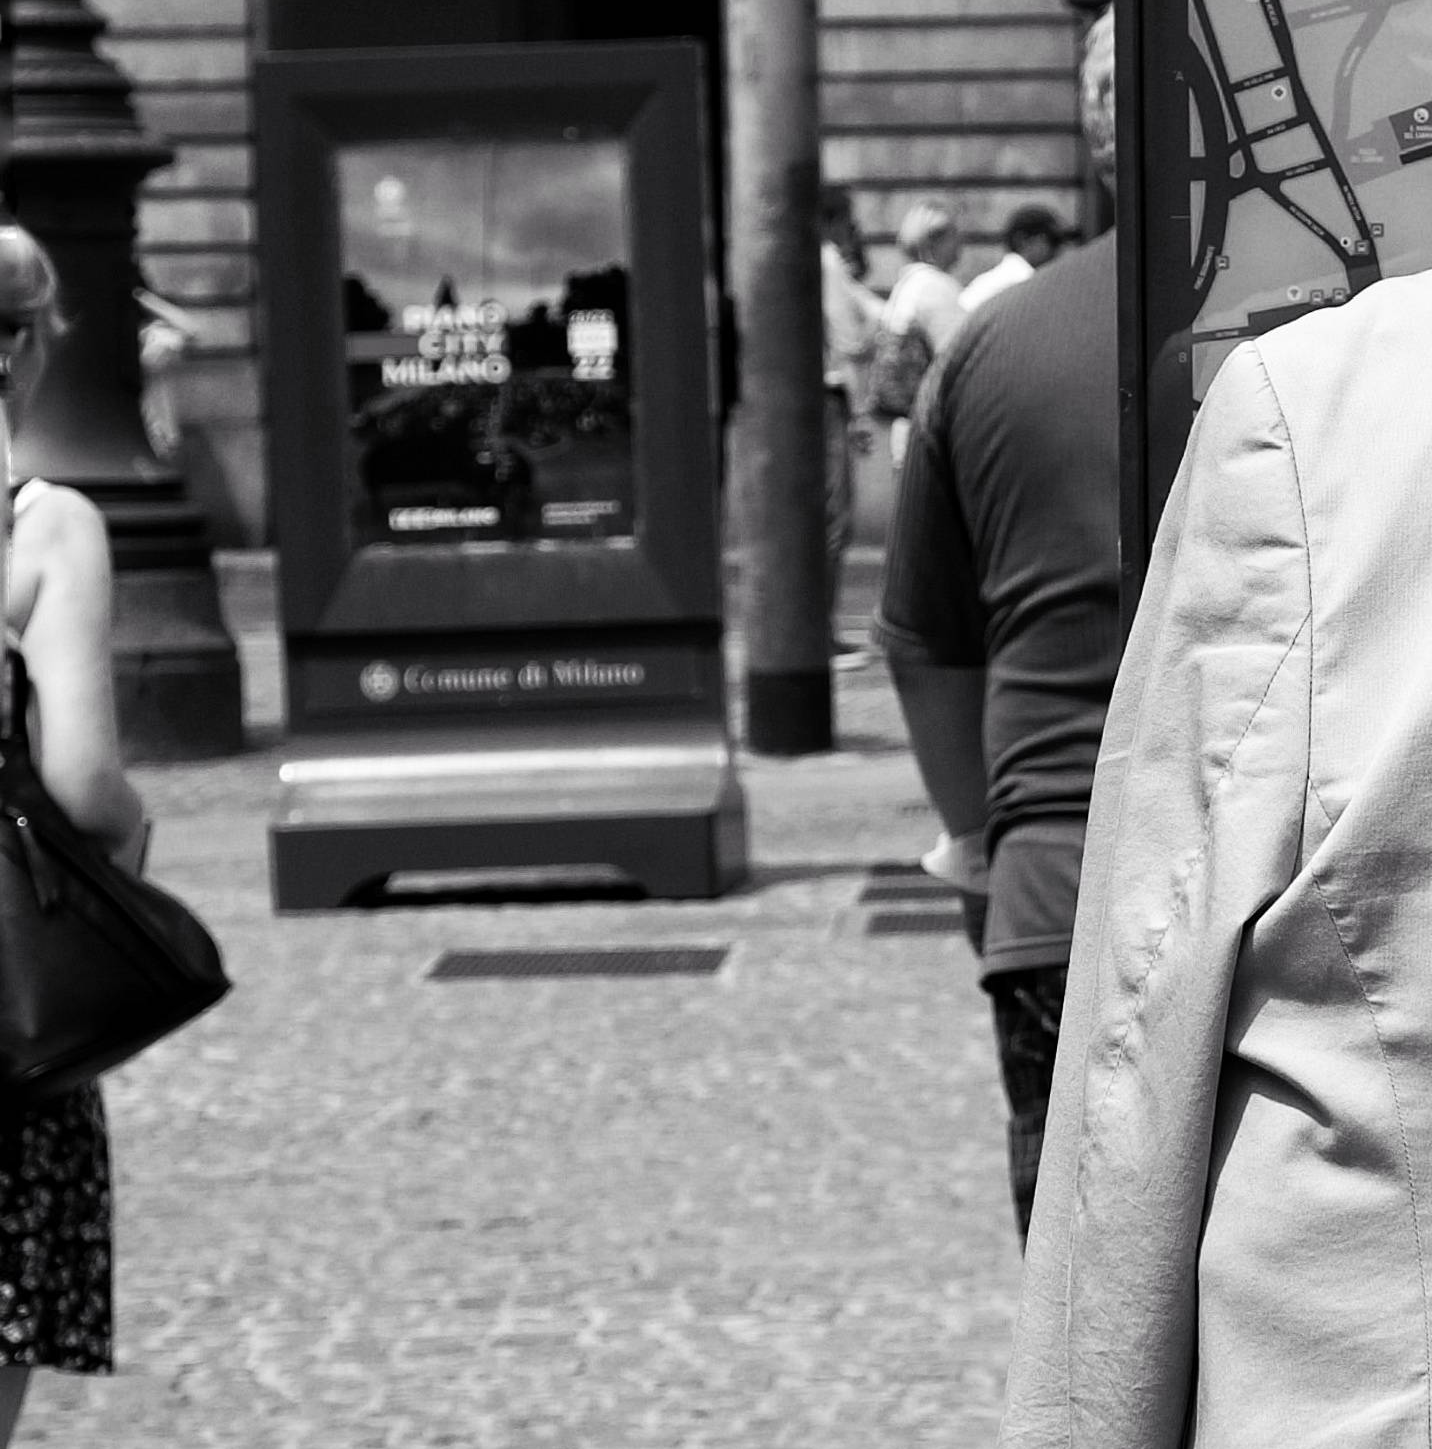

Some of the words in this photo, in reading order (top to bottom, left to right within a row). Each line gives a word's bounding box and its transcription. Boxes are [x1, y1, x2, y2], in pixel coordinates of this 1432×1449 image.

[382, 353, 512, 387] MILANO
[403, 663, 514, 695] Comune
[518, 660, 548, 690] di
[552, 657, 646, 688] Milano
